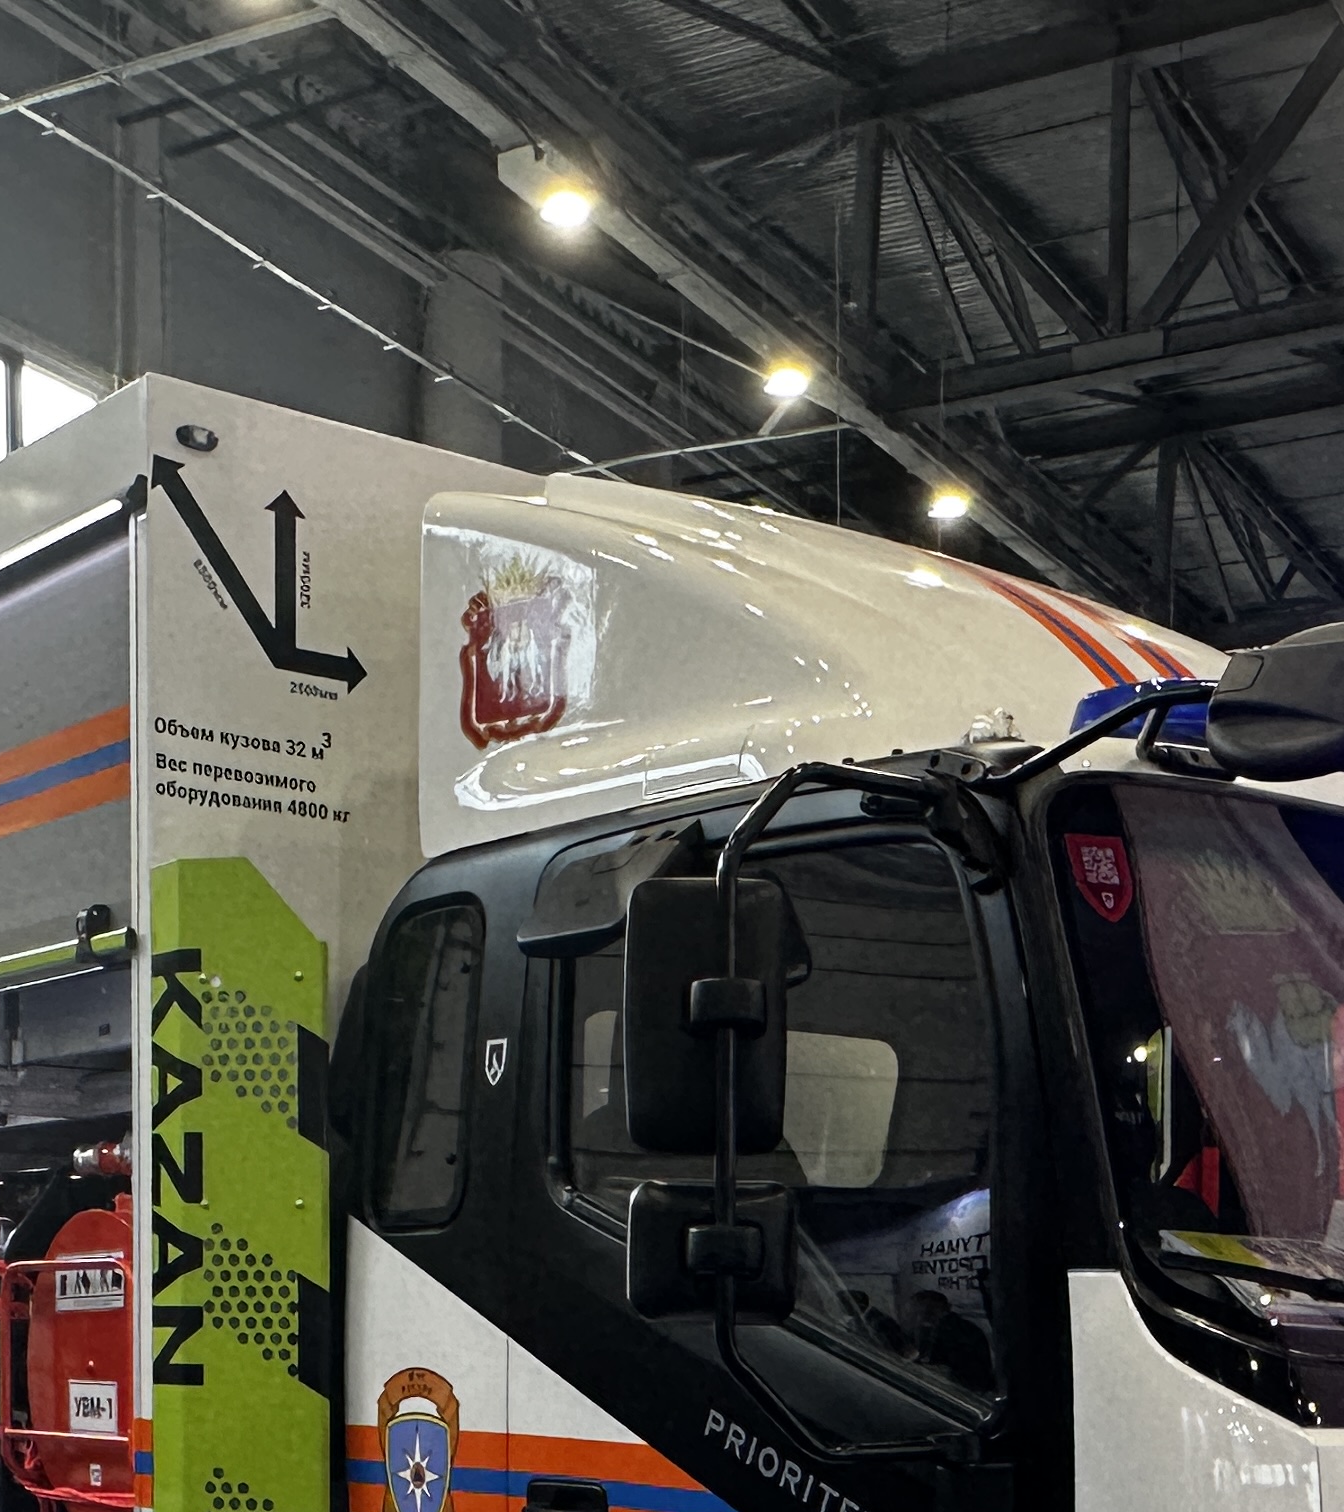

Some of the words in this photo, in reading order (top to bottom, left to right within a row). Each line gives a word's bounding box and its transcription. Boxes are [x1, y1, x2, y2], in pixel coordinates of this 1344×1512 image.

[220, 731, 280, 750] кузова
[285, 739, 307, 758] 32
[156, 752, 187, 773] Вес
[193, 761, 316, 793] перевозимого
[156, 780, 282, 814] оборудования
[287, 799, 328, 820] 4800
[332, 808, 351, 823] кг
[152, 948, 204, 1385] KAZAN
